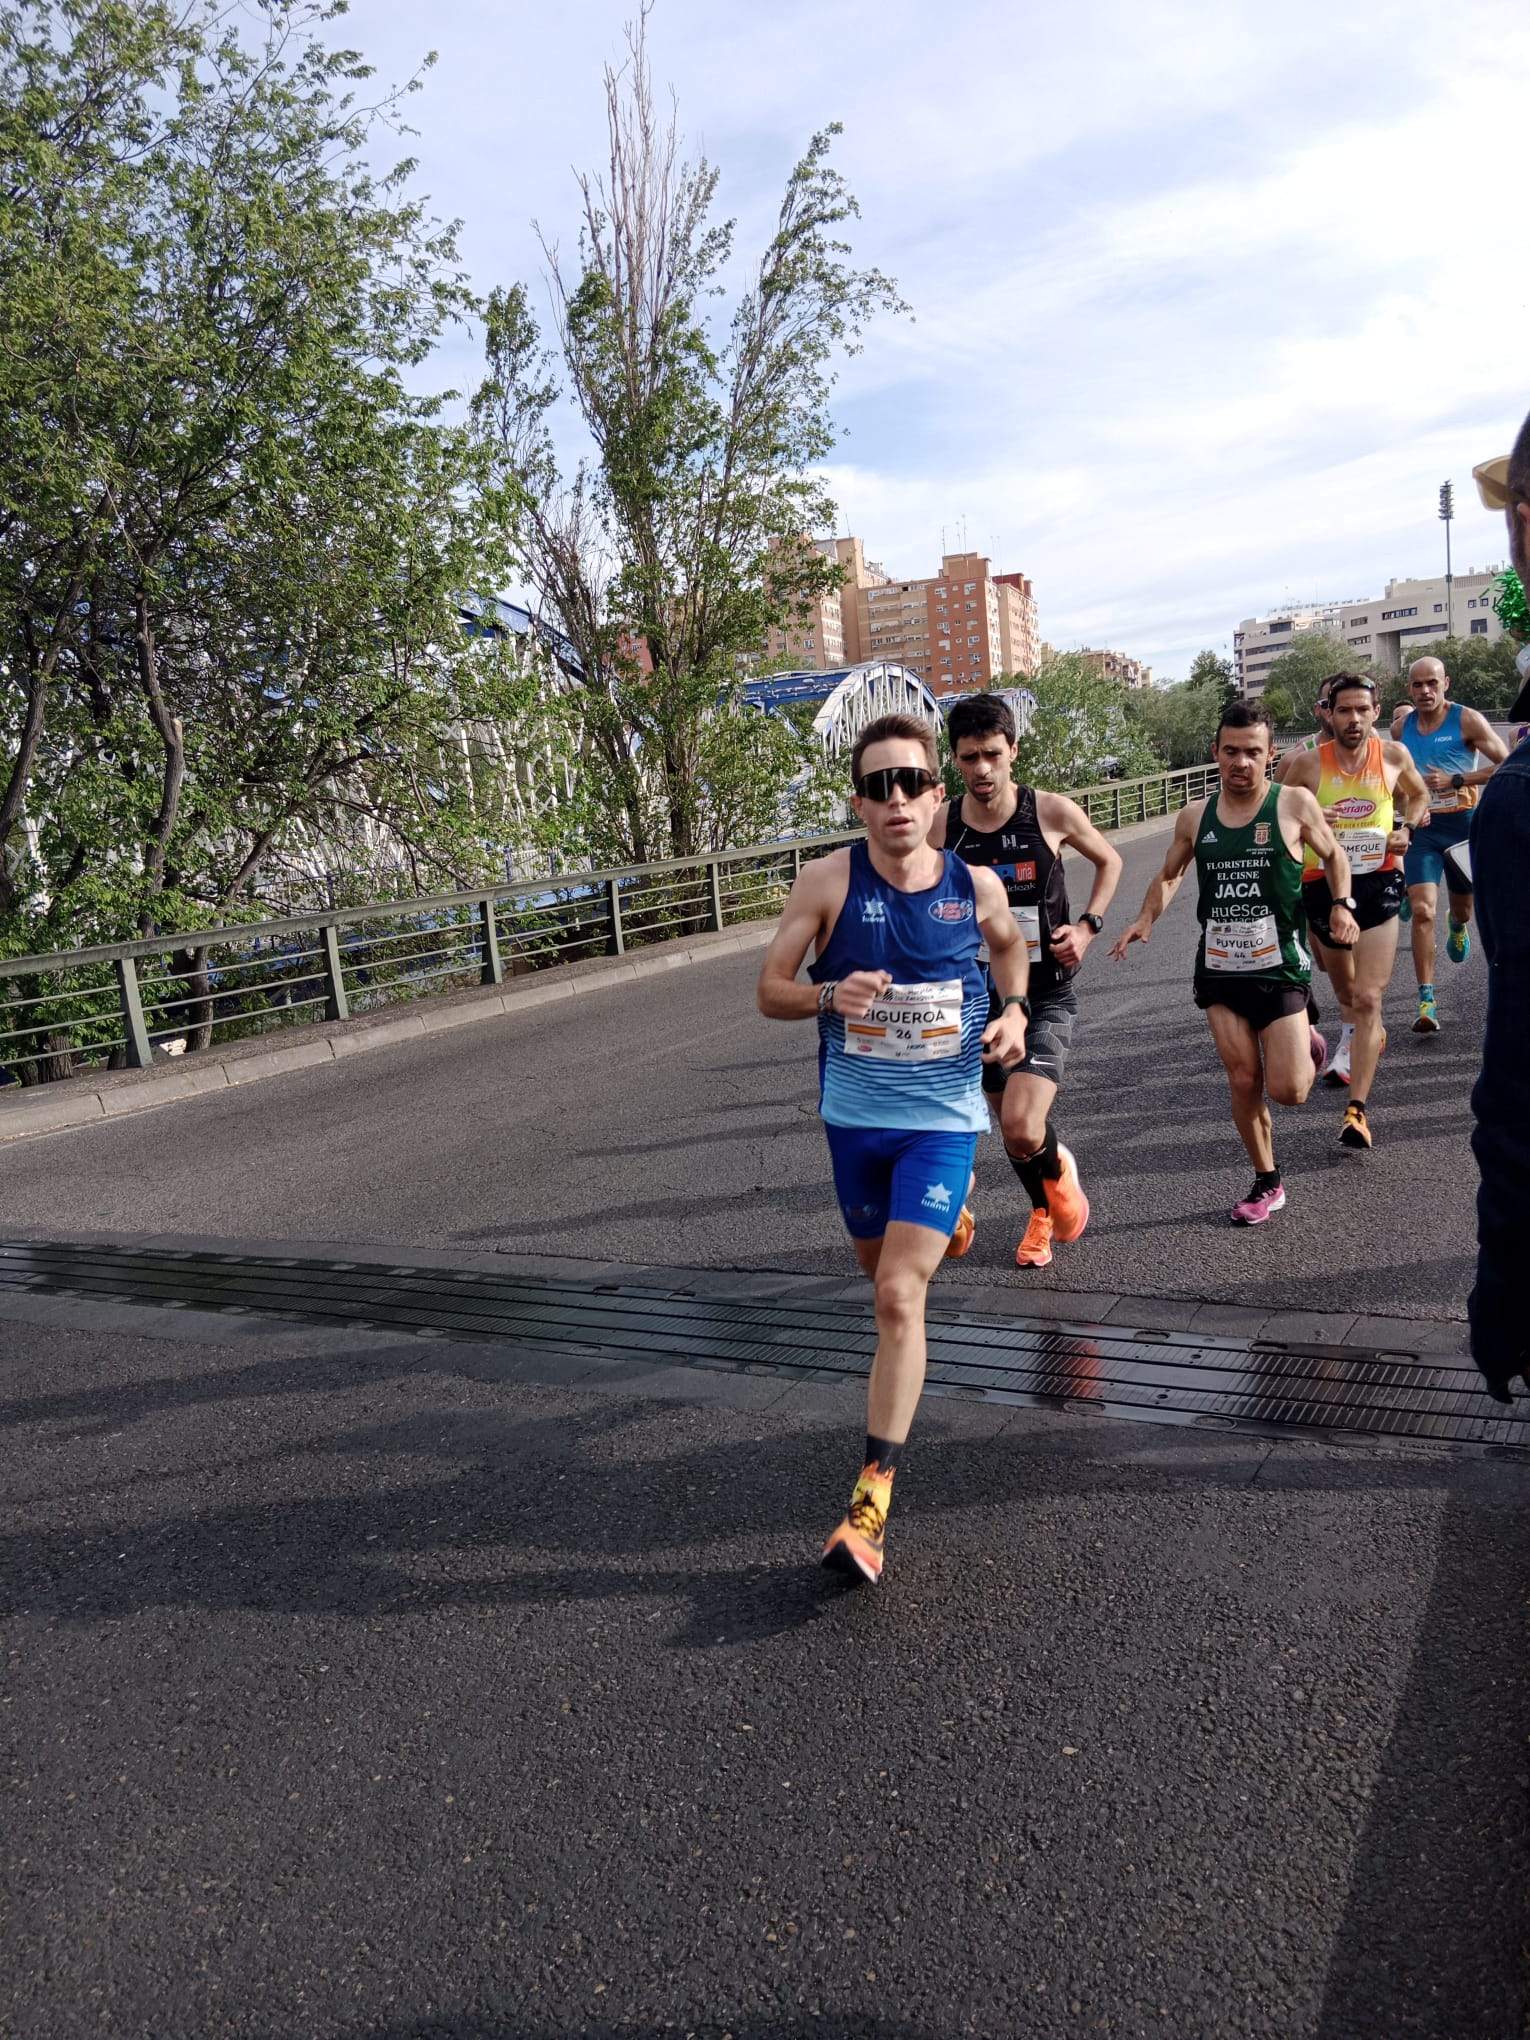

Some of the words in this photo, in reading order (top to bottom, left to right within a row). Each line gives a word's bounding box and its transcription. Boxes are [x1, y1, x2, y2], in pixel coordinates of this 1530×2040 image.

[1343, 804, 1373, 813] errano
[1207, 857, 1271, 870] FLORISTERÍA
[1217, 872, 1229, 881] EL
[1230, 871, 1260, 880] CISNE
[1214, 882, 1262, 899] JACA
[1216, 937, 1264, 949] PUYUELO
[896, 1029, 912, 1040] 26
